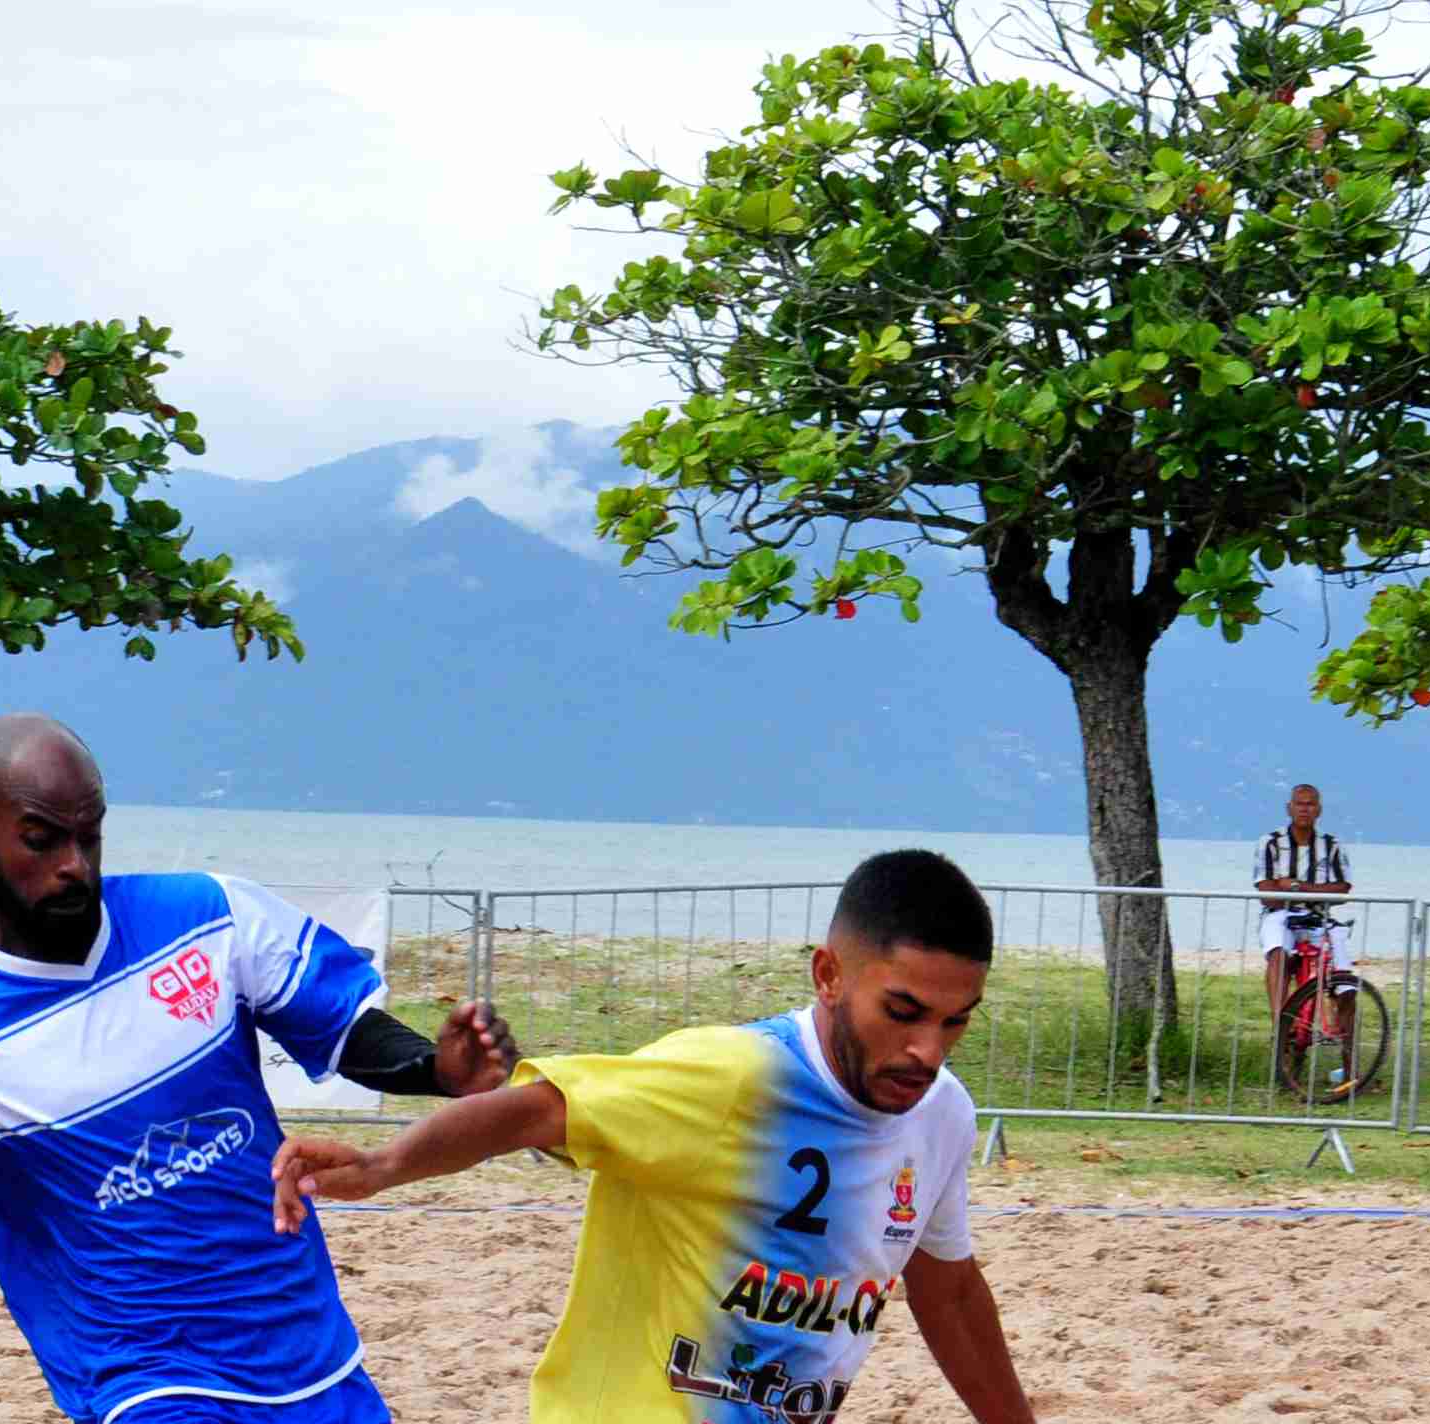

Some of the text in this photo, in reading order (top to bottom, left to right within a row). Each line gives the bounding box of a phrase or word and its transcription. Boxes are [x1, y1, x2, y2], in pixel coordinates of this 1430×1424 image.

[95, 1122, 244, 1210] PICO SPORTS
[776, 1147, 831, 1236] 2
